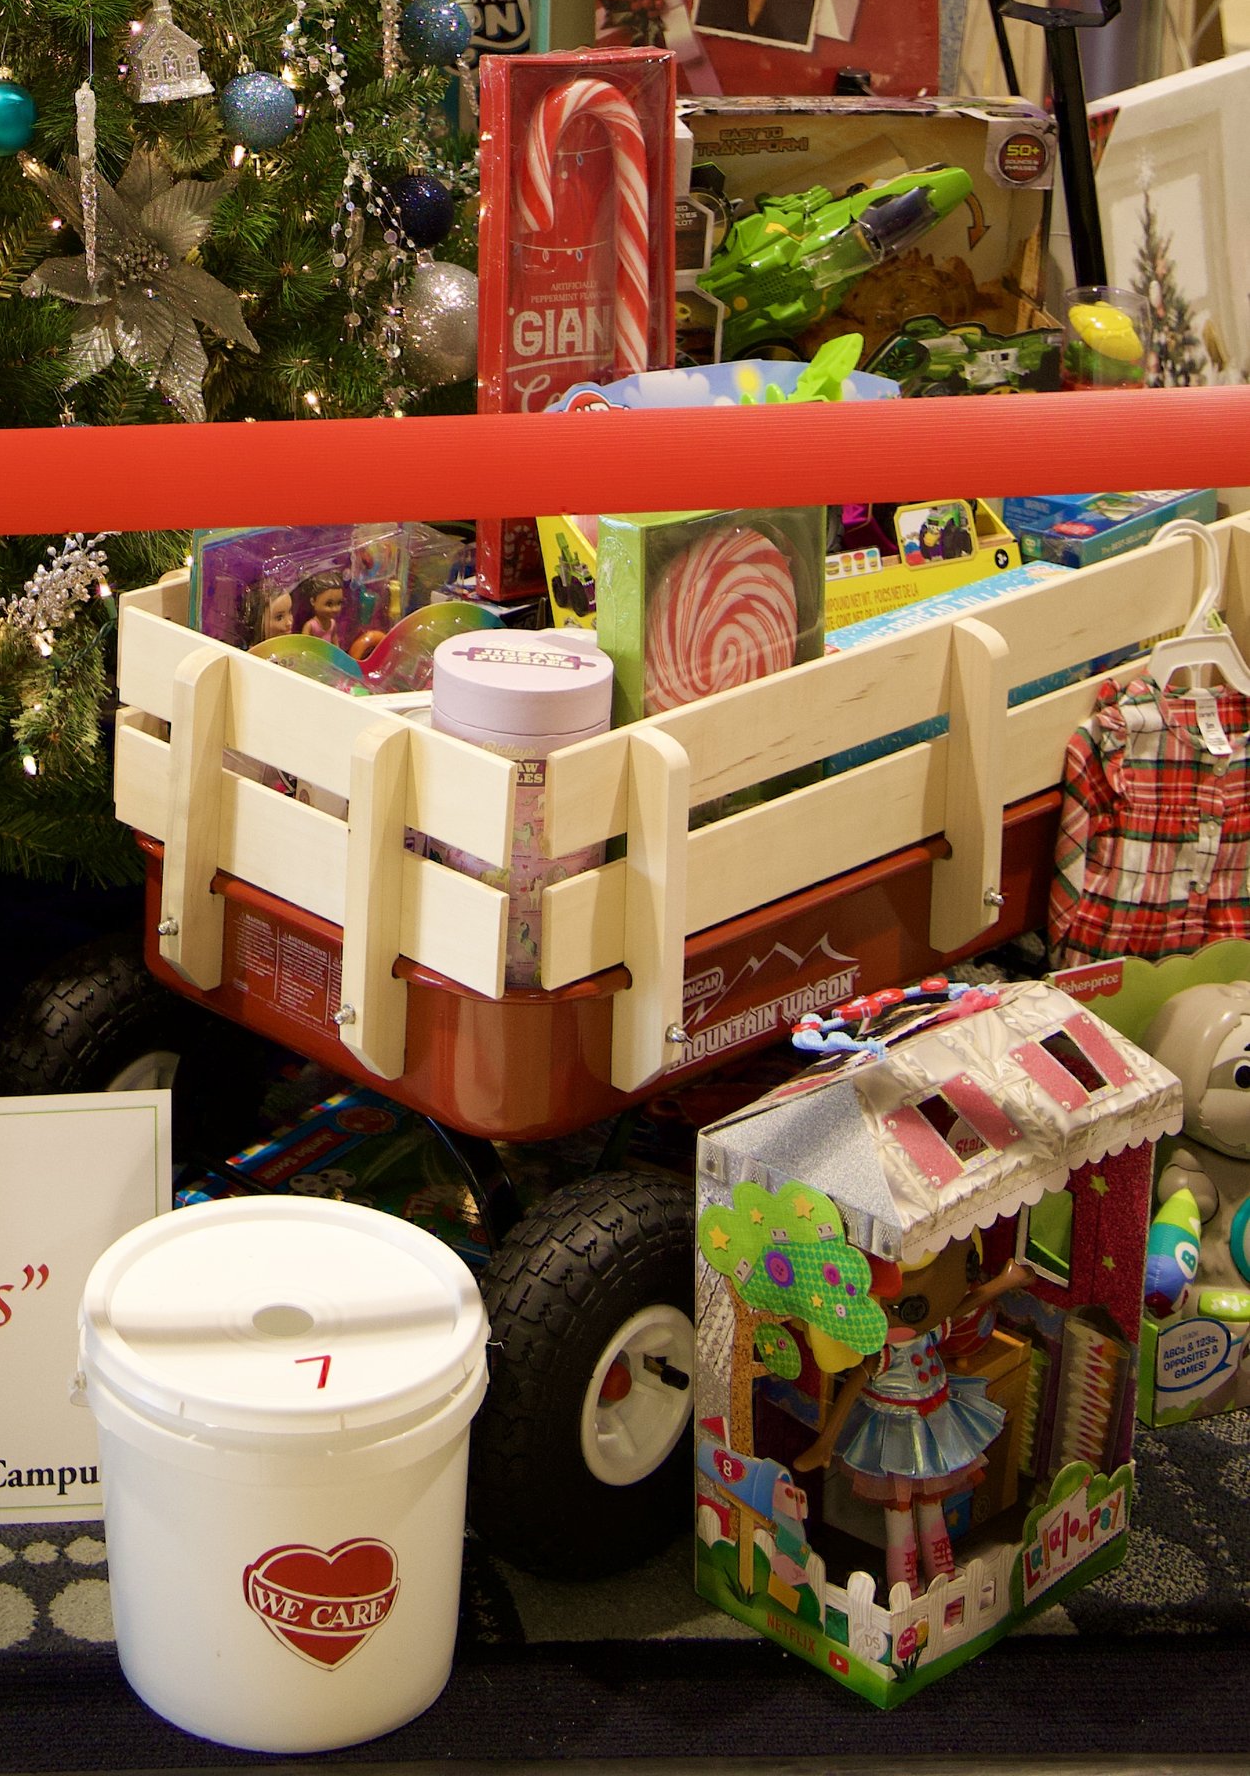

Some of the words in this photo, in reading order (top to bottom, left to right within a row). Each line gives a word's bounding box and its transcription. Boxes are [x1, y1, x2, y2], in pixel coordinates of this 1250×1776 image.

[1006, 144, 1040, 156] 50+
[512, 306, 615, 357] GIAN
[473, 653, 575, 669] PUZZLES
[481, 648, 570, 661] JIGSAW
[780, 969, 857, 1025] WAGON
[293, 1354, 332, 1391] 7
[253, 1584, 304, 1623] WE
[310, 1596, 387, 1628] CARE
[766, 1610, 818, 1655] NETFLIX
